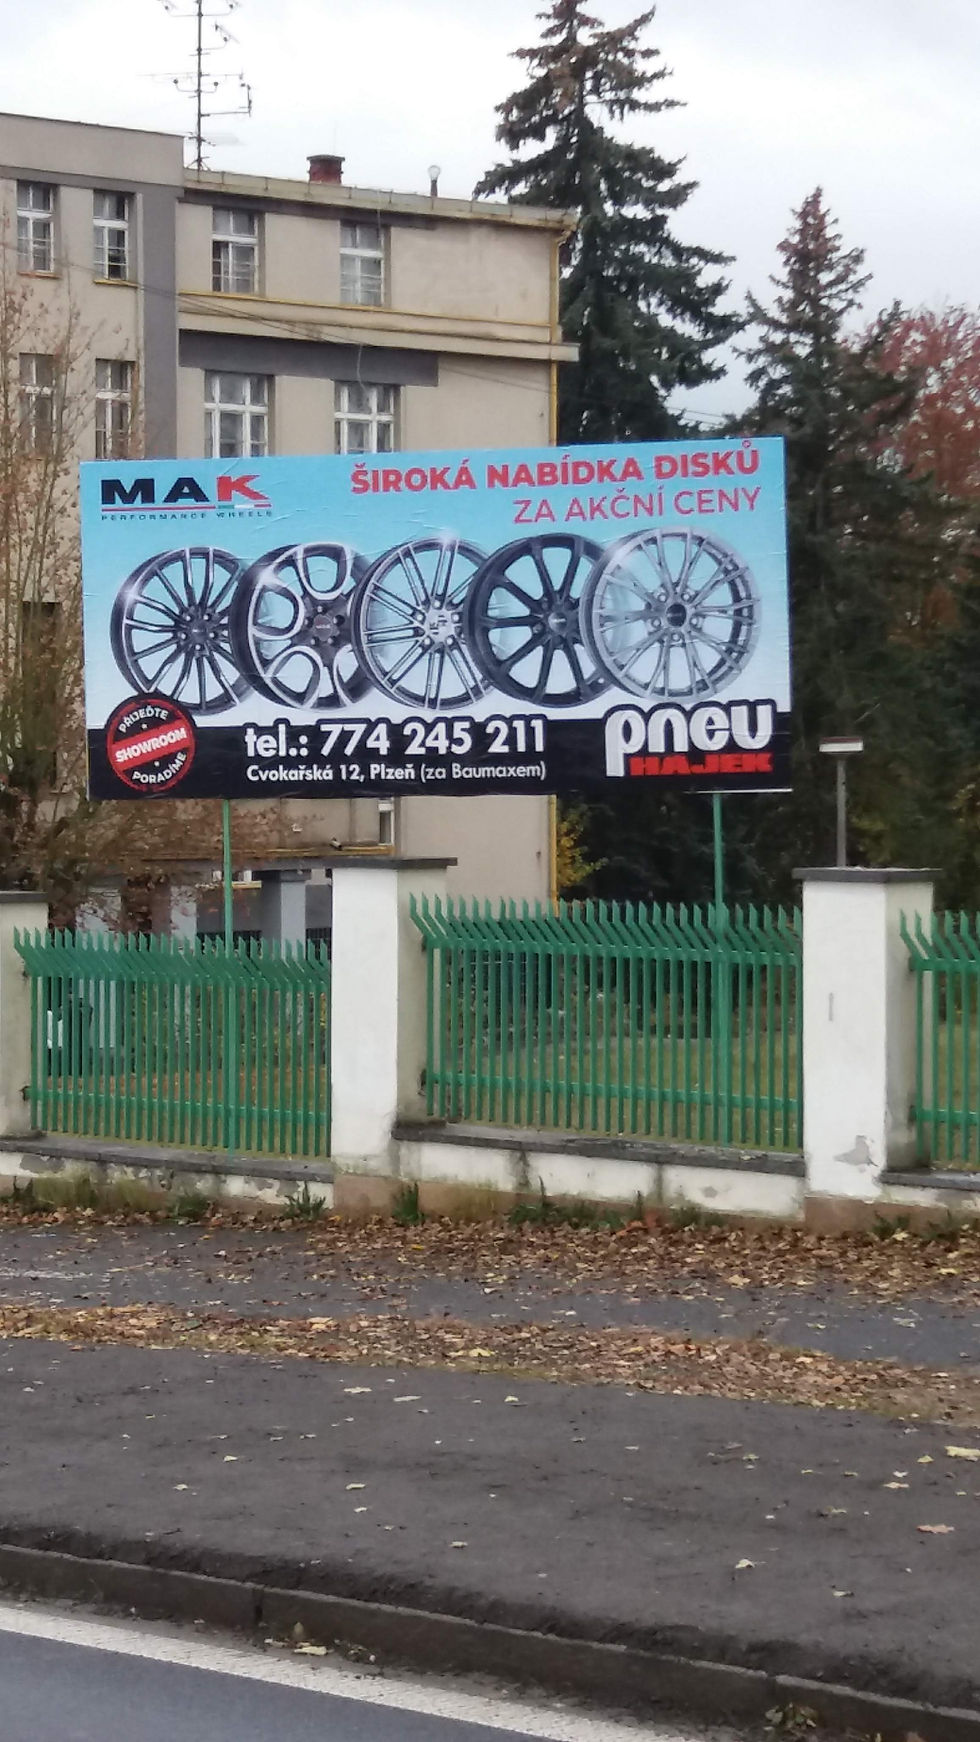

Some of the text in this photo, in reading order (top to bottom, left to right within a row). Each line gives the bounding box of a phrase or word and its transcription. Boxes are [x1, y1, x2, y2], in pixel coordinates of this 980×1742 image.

[351, 440, 760, 494] ŠIROKÁ NABÍDKA DISKŮ
[101, 475, 269, 504] MAK
[513, 486, 761, 524] ZA AKČNÍ CENY
[101, 511, 272, 521] PERFORMANCE WHEELS
[118, 706, 169, 733] PŘIJEĎTE
[115, 728, 187, 763] SHOWROOM
[244, 720, 545, 757] tel.: 774 245 211
[605, 704, 773, 777] pneu
[132, 752, 187, 784] PORADÍME
[246, 761, 547, 782] Cvokařská 12, Plzeň (za Baumaxem)
